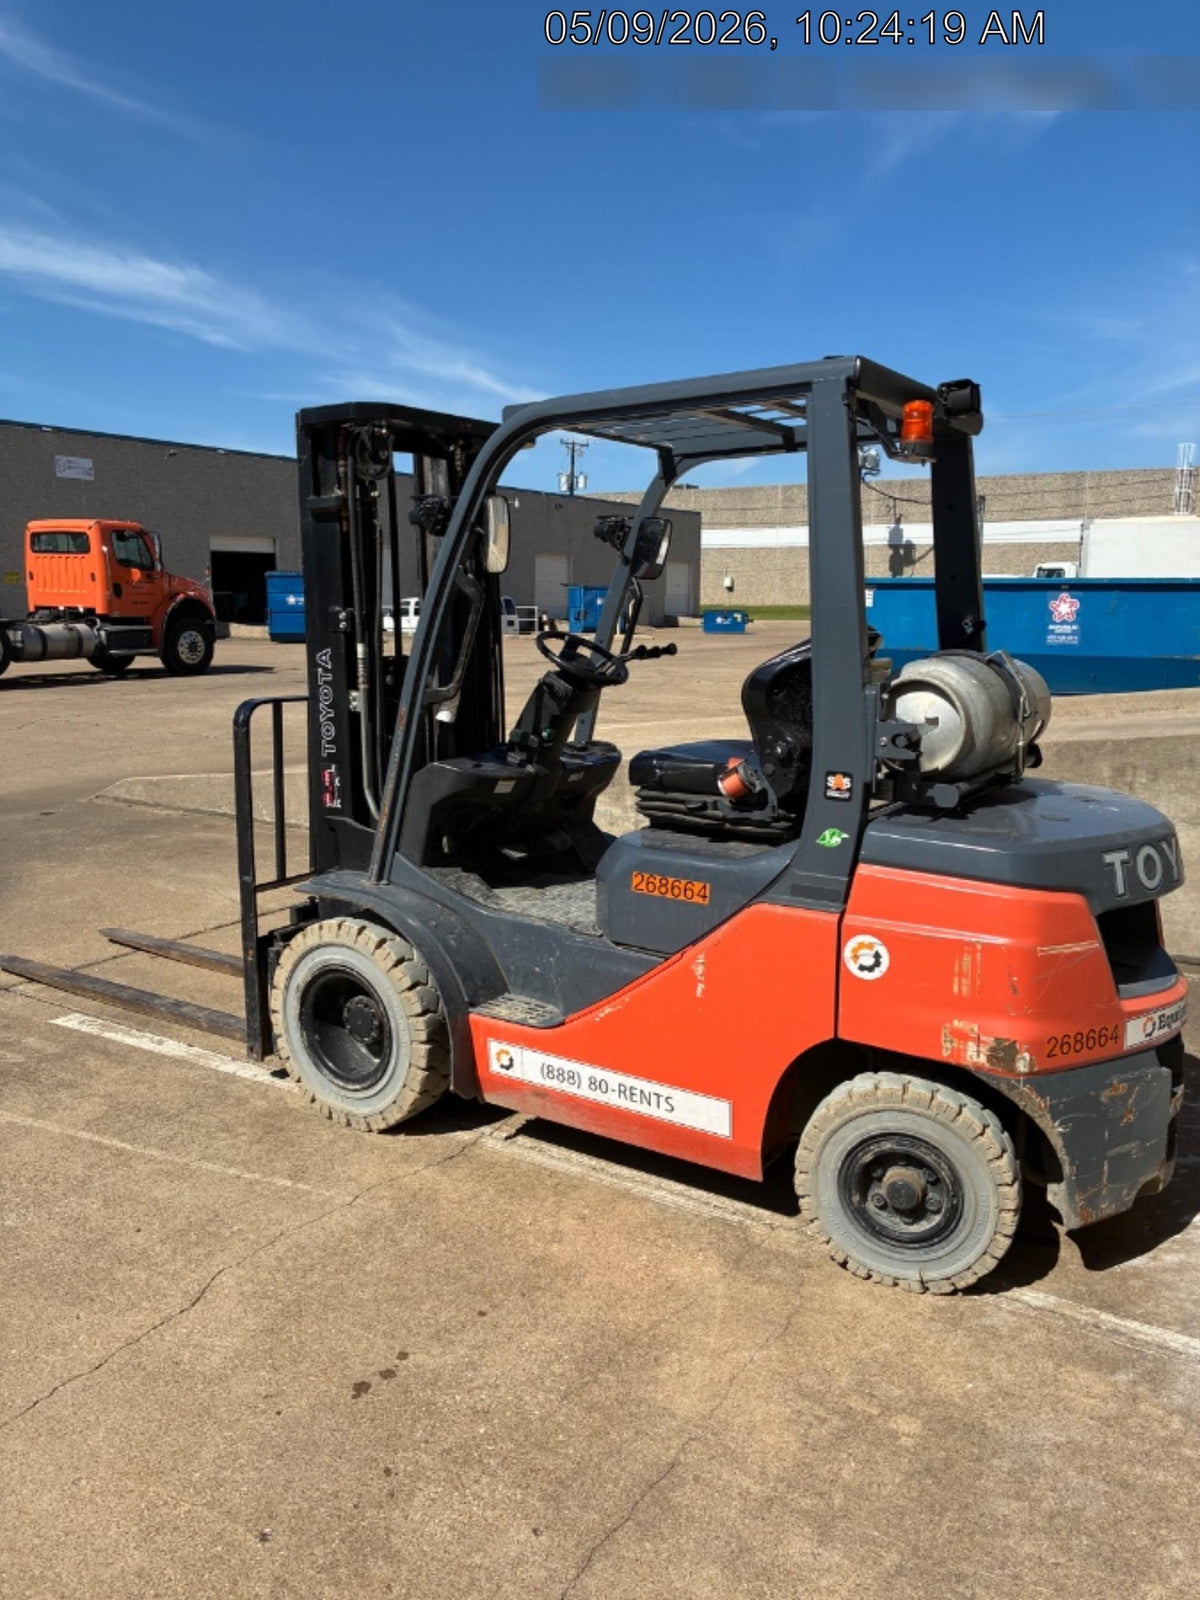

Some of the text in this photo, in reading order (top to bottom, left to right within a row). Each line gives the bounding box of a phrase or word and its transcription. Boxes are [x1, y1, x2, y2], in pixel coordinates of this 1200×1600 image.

[316, 648, 336, 757] TOYOTA
[633, 872, 709, 902] 268664
[1101, 836, 1179, 897] TOY
[1045, 1023, 1120, 1059] 268664
[540, 1062, 676, 1114] (888) 80-RENTS
